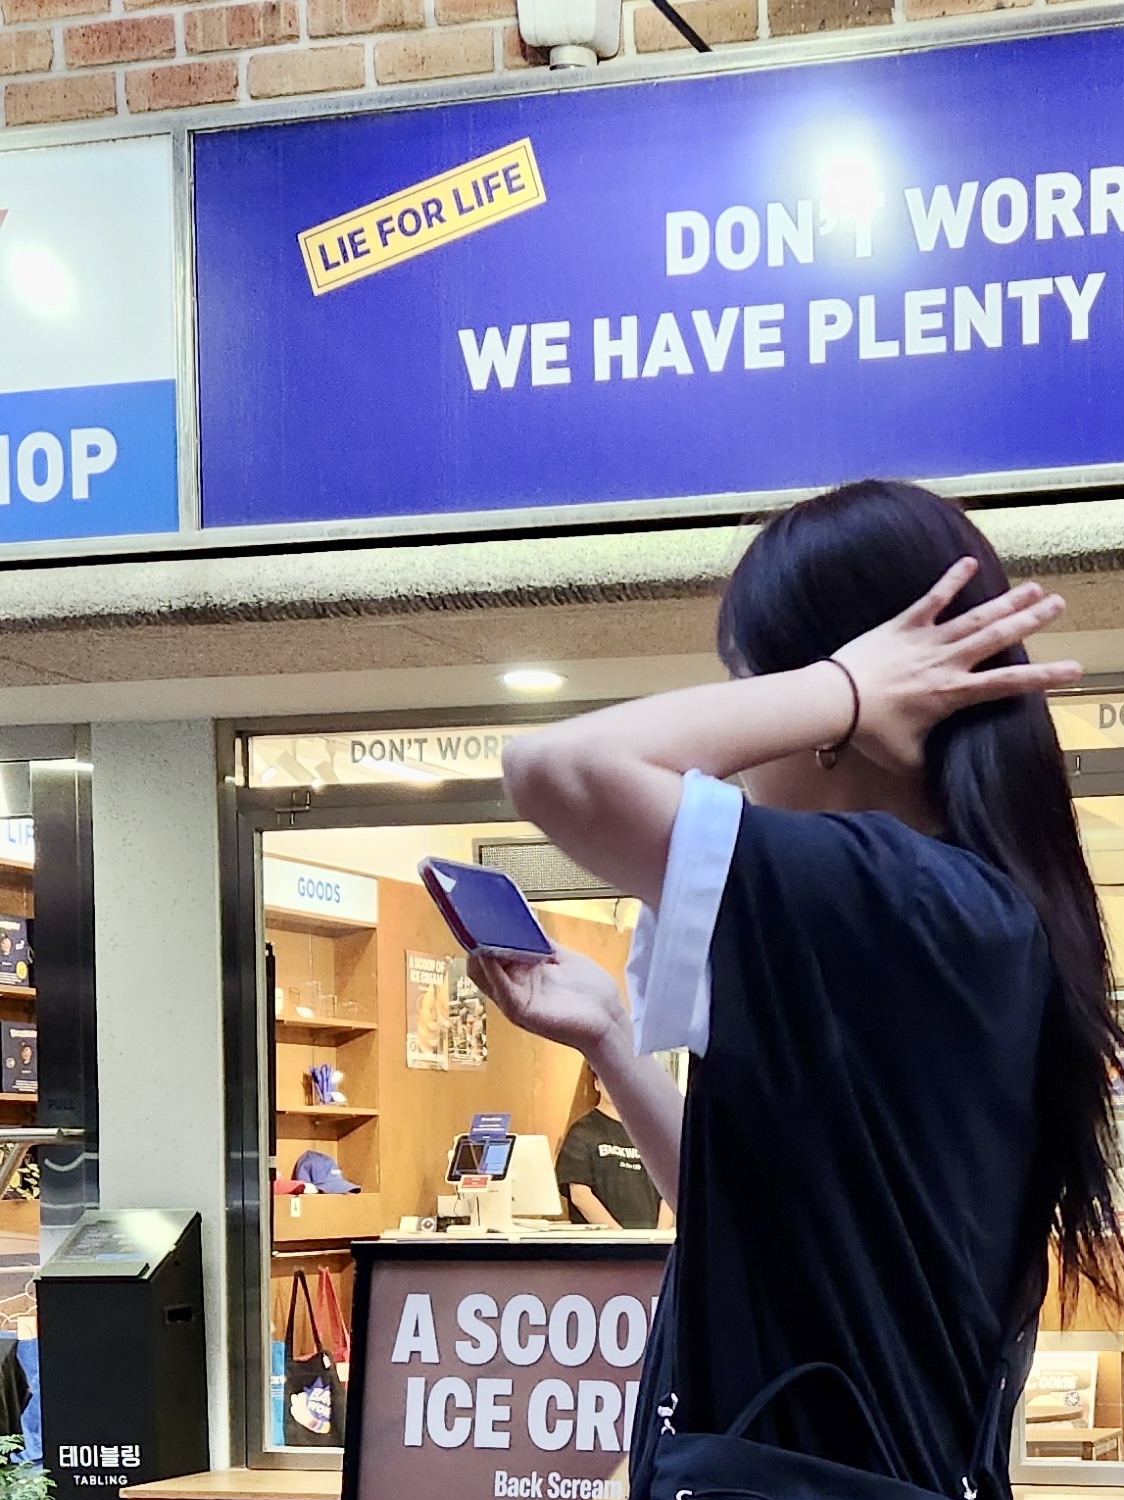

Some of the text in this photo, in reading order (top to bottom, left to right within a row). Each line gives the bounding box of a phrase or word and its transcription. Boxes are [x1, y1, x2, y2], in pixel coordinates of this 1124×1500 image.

[318, 161, 526, 272] LIE FOR LIFE
[458, 320, 572, 391] WE
[593, 303, 785, 382] HAVE
[809, 272, 1105, 365] PLENTY
[350, 737, 428, 764] DON'T
[297, 876, 341, 904] GOODS
[391, 1293, 658, 1368] A SCOO
[403, 1376, 513, 1449] ICE
[59, 1444, 141, 1468] 테이블링
[73, 1474, 128, 1486] TABLING
[494, 1470, 625, 1500] Back Scream
